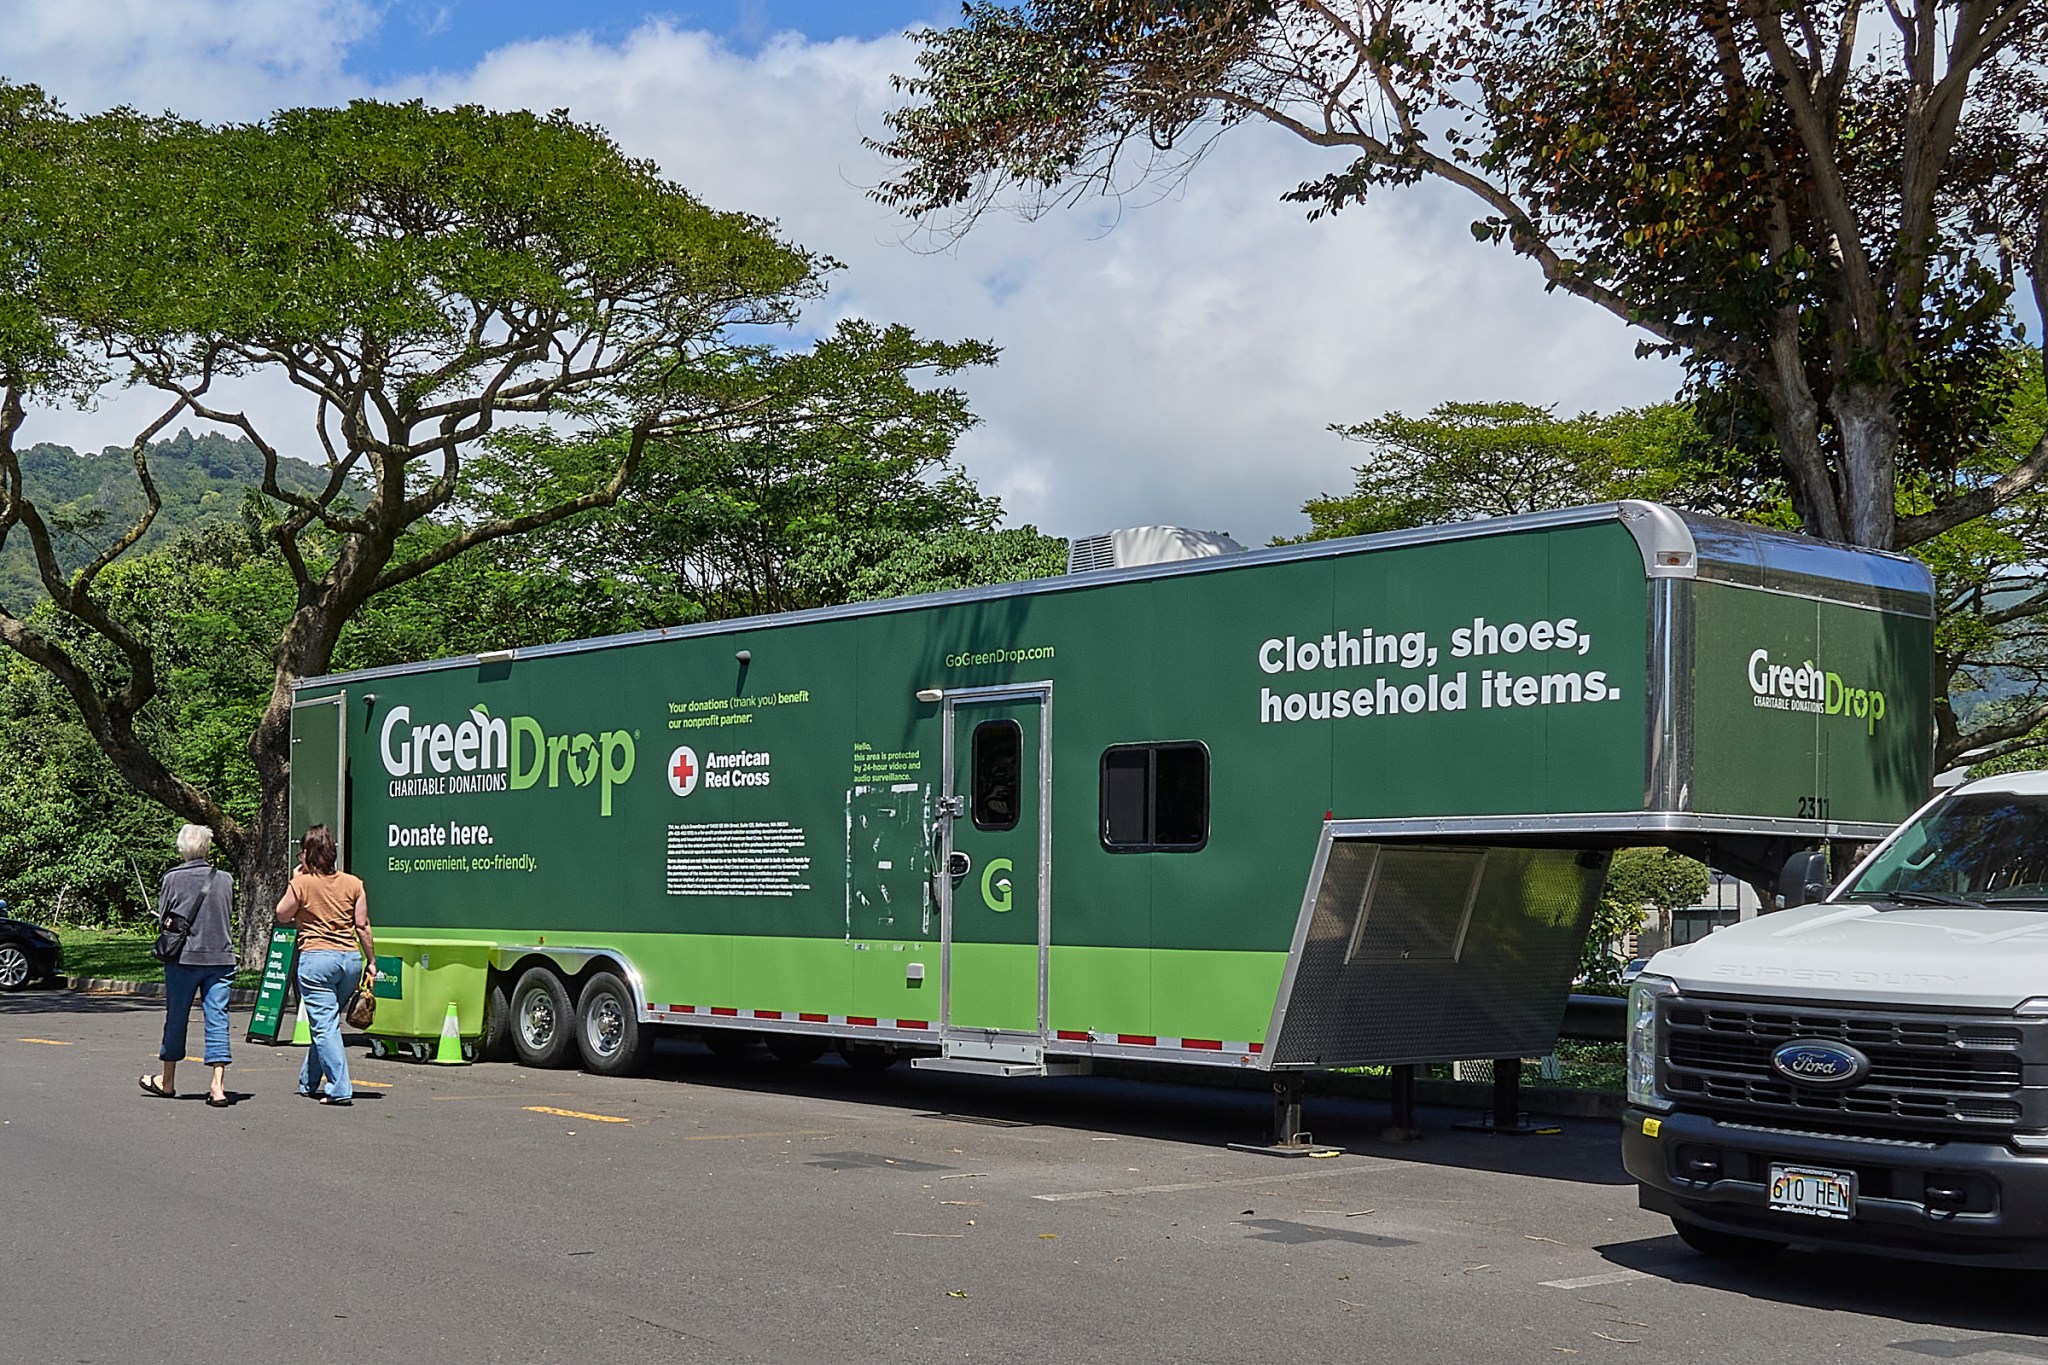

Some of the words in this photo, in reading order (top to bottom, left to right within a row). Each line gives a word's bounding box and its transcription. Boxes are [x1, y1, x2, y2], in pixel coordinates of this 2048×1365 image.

[1258, 627, 1438, 674] Clothing,
[1450, 616, 1591, 658] shoes,
[945, 645, 1055, 668] GoGreenDrop.com
[668, 702, 687, 714] Your
[688, 699, 728, 712] donations
[730, 696, 756, 710] (thank
[757, 694, 777, 708] you)
[778, 690, 810, 705] benefit
[1260, 671, 1467, 723] household
[1481, 670, 1621, 709] items.
[1753, 694, 1790, 711] CHARITABLE
[1791, 699, 1825, 714] DONATIONS
[668, 719, 682, 729] our
[683, 715, 719, 729] nonprofit
[720, 713, 753, 727] partner:
[854, 742, 872, 751] Hello,
[854, 752, 865, 761] this
[866, 753, 880, 761] area
[881, 751, 887, 760] is
[888, 750, 920, 761] protected
[706, 750, 770, 769] American
[854, 764, 862, 773] by
[863, 762, 888, 772] 24-hour
[889, 761, 907, 770] video
[908, 761, 921, 770] and
[389, 776, 445, 798] CHARITABLE
[449, 772, 507, 794] DONATIONS
[705, 771, 730, 788] Red
[732, 769, 770, 787] Cross
[854, 773, 871, 782] audio
[872, 772, 912, 782] surveillance.
[388, 822, 446, 847] Donate
[451, 820, 494, 845] here.
[388, 856, 412, 874] Easy,
[413, 855, 469, 873] convenient,
[471, 853, 538, 873] eco-friendly.
[981, 858, 1013, 913] G
[1711, 963, 1841, 982] SUPER
[1850, 970, 1969, 987] DUTY
[1792, 1052, 1837, 1074] Ford
[1773, 1176, 1805, 1202] 610
[1815, 1179, 1849, 1208] HEN
